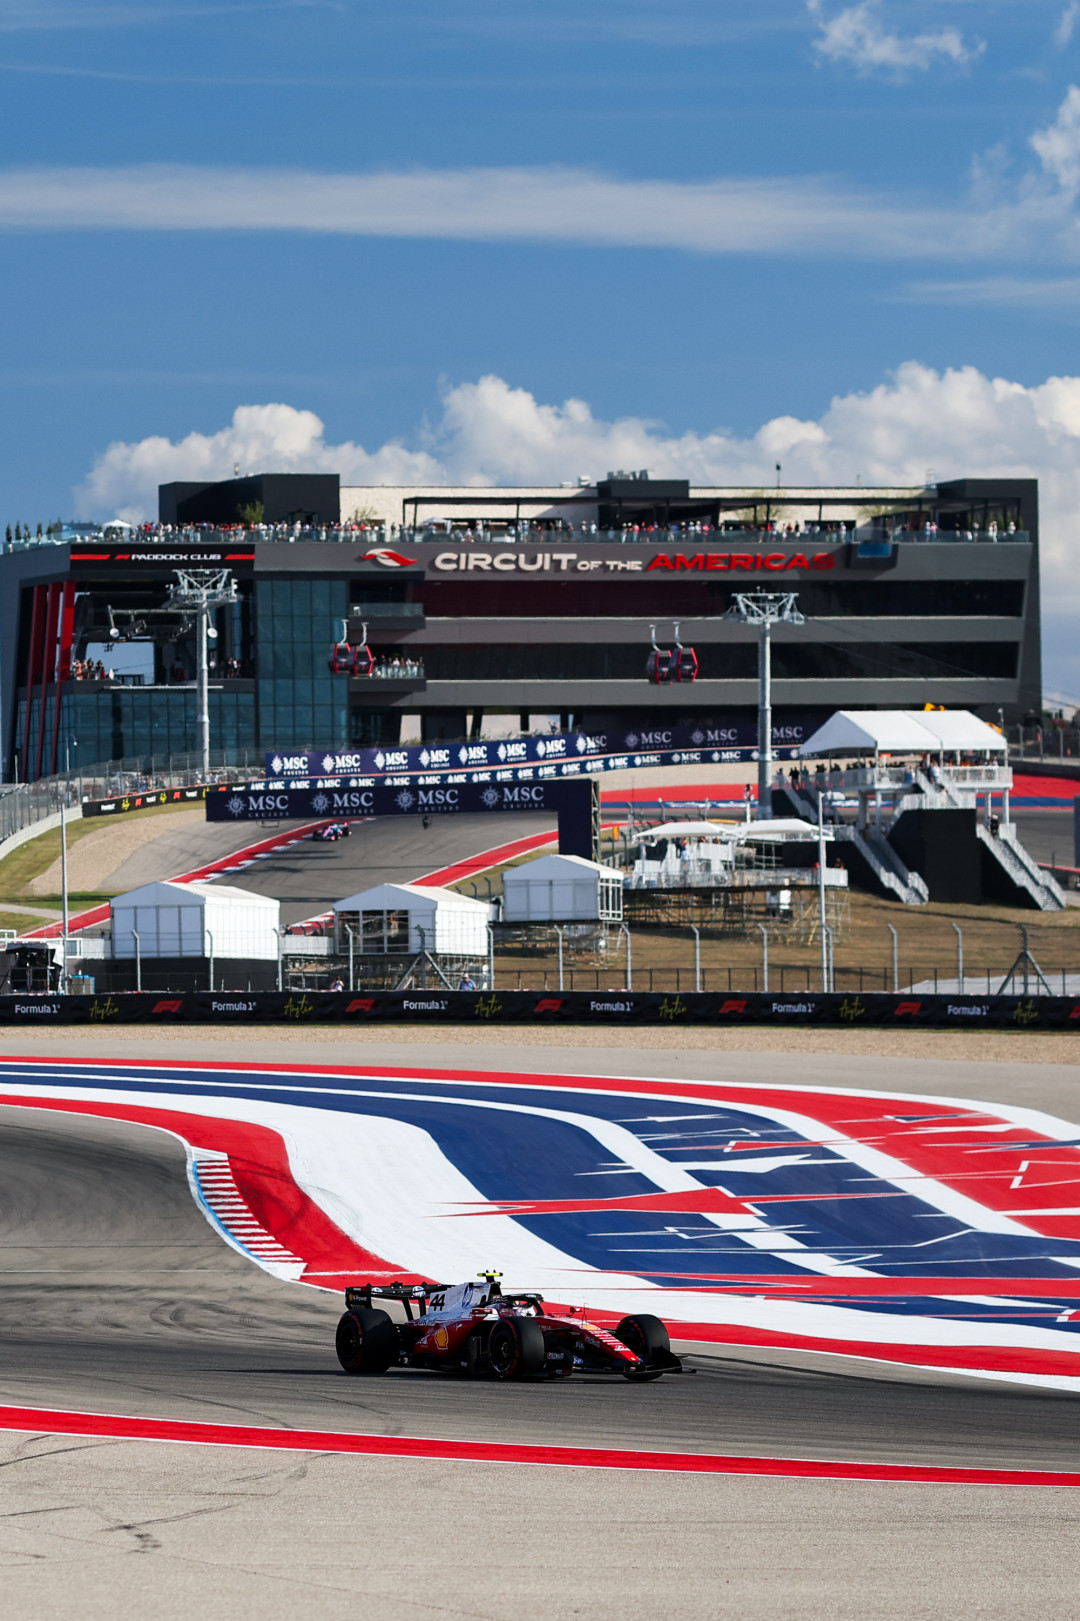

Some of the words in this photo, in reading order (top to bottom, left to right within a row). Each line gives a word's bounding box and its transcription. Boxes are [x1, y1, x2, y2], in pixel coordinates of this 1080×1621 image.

[434, 552, 577, 571] CIRCUIT
[576, 560, 602, 571] OF
[605, 560, 643, 571] THE
[648, 552, 836, 571] AMERICAS
[641, 732, 672, 744] MSC
[706, 729, 738, 741] MSC
[468, 746, 488, 760] MSC
[507, 743, 526, 757] MSC
[546, 739, 566, 753] MSC
[335, 754, 360, 768] MSC
[386, 752, 408, 766] MSC
[430, 749, 450, 763] MSC
[681, 753, 701, 761] MSC
[721, 751, 741, 759] MSC
[283, 757, 308, 770] MSC
[334, 792, 374, 807] MSC
[418, 789, 458, 804] MSC
[503, 786, 544, 802] MSC
[249, 795, 289, 810] MSC
[14, 1004, 50, 1014] Formula
[89, 996, 119, 1019] Austin
[212, 1002, 247, 1010] Formula
[403, 1000, 439, 1010] Formula
[591, 1002, 625, 1011] Formula
[772, 1003, 806, 1013] Formula
[948, 1005, 981, 1015] Formula
[430, 1294, 446, 1311] 44
